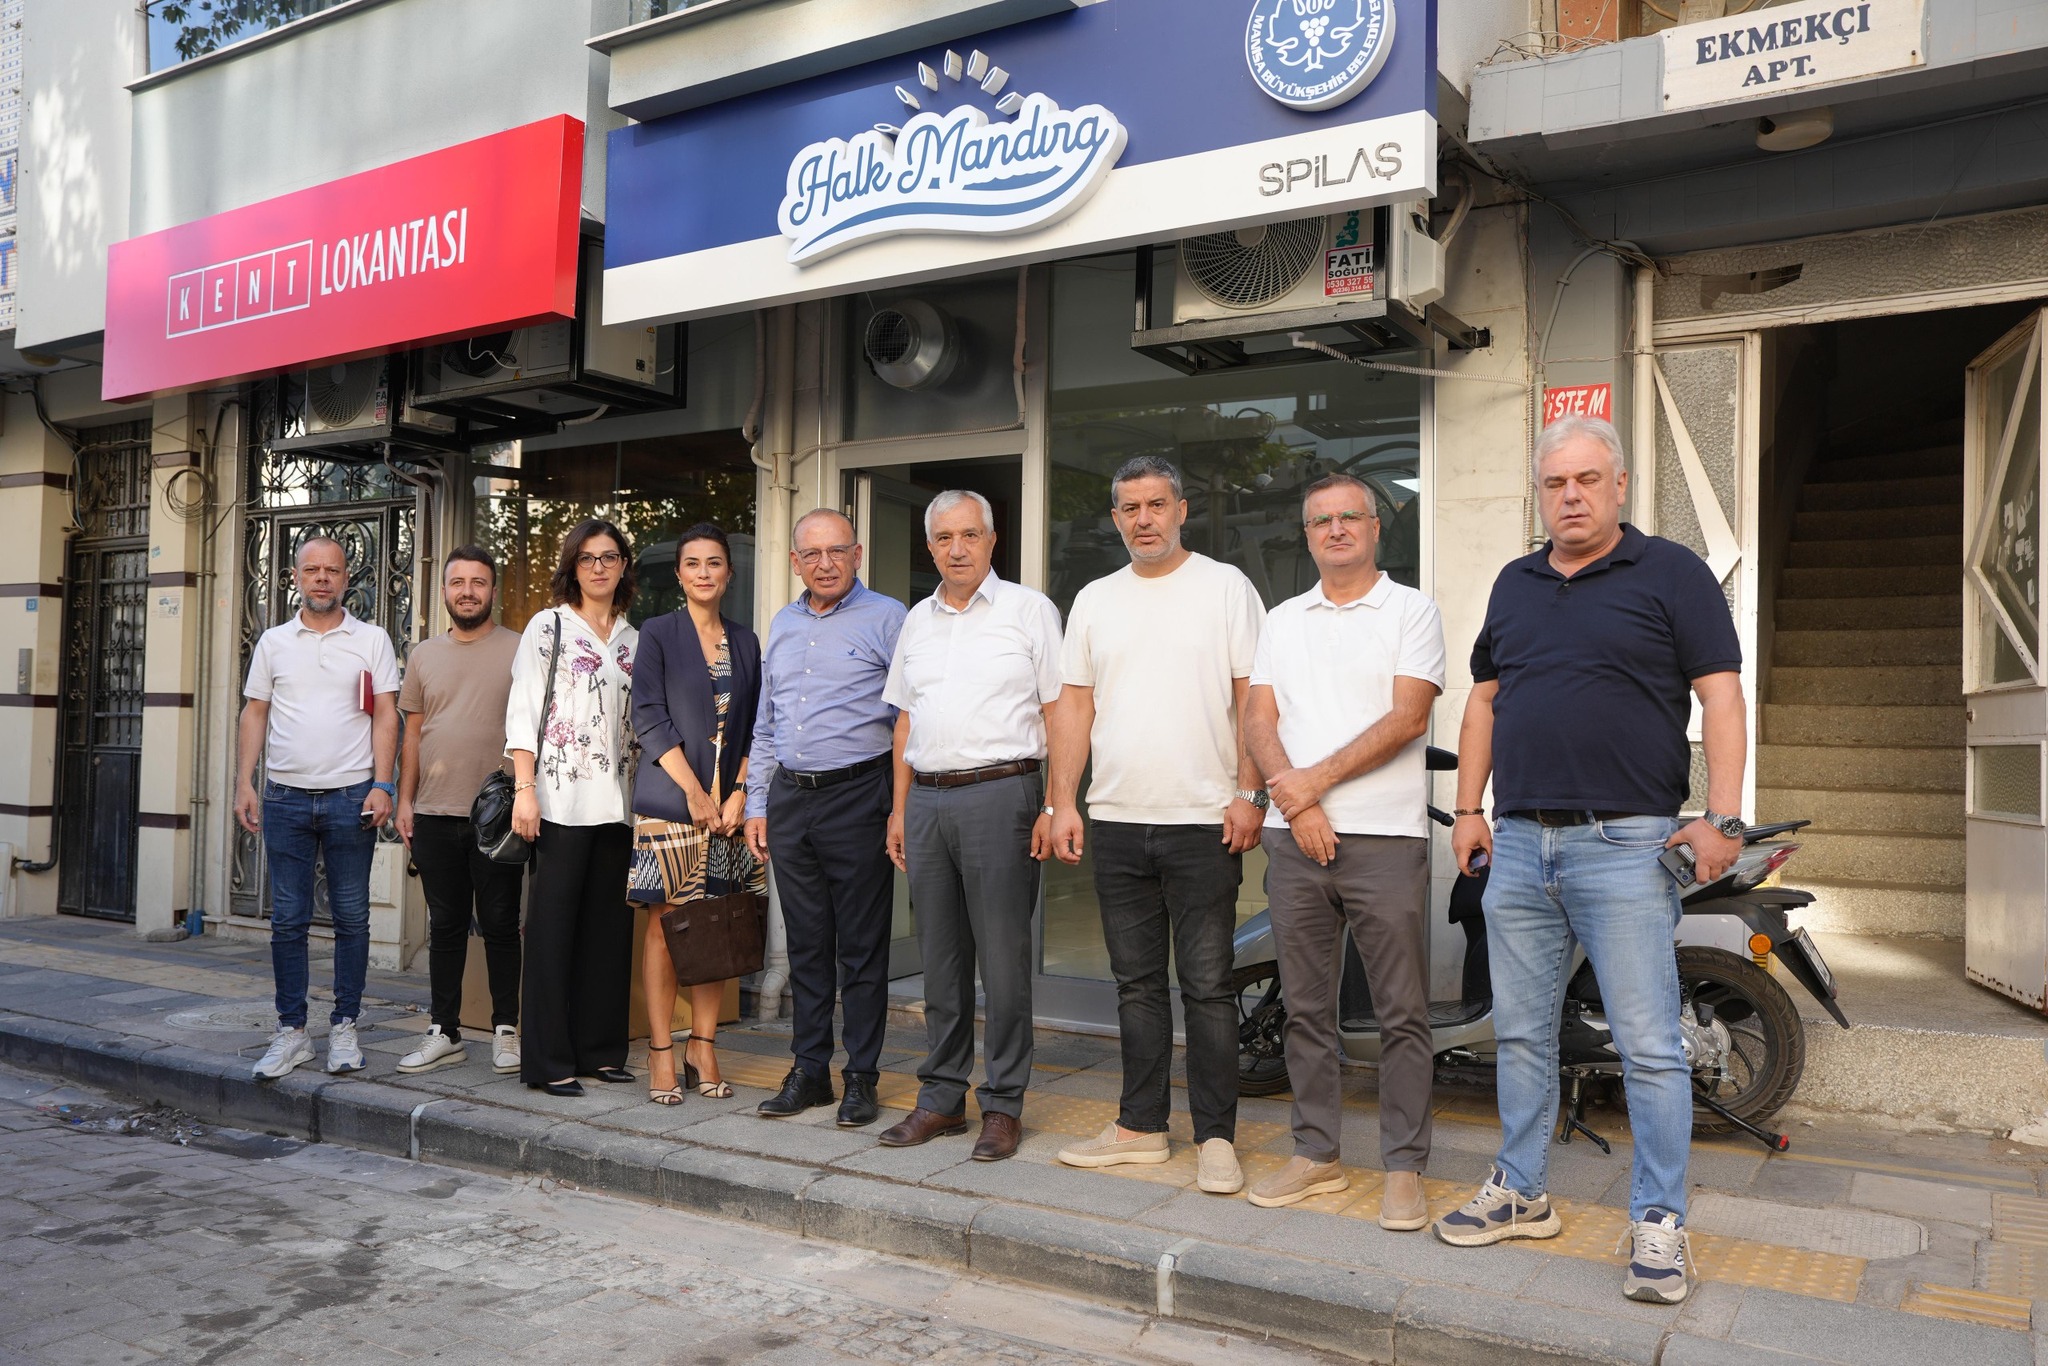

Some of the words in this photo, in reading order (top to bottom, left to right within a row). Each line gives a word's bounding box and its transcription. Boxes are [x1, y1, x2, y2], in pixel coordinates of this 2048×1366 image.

[1250, 14, 1266, 74] MANİSA
[1260, 69, 1349, 100] BÜYÜKŞEHİR
[1346, 0, 1382, 76] BELEDİYE
[1741, 54, 1817, 88] APT.
[789, 142, 892, 226] Halk
[179, 259, 297, 321] KENT
[320, 207, 468, 296] LOKANTASI
[1326, 279, 1345, 289] 0530
[1347, 277, 1362, 286] 327
[1328, 248, 1373, 269] FATİ
